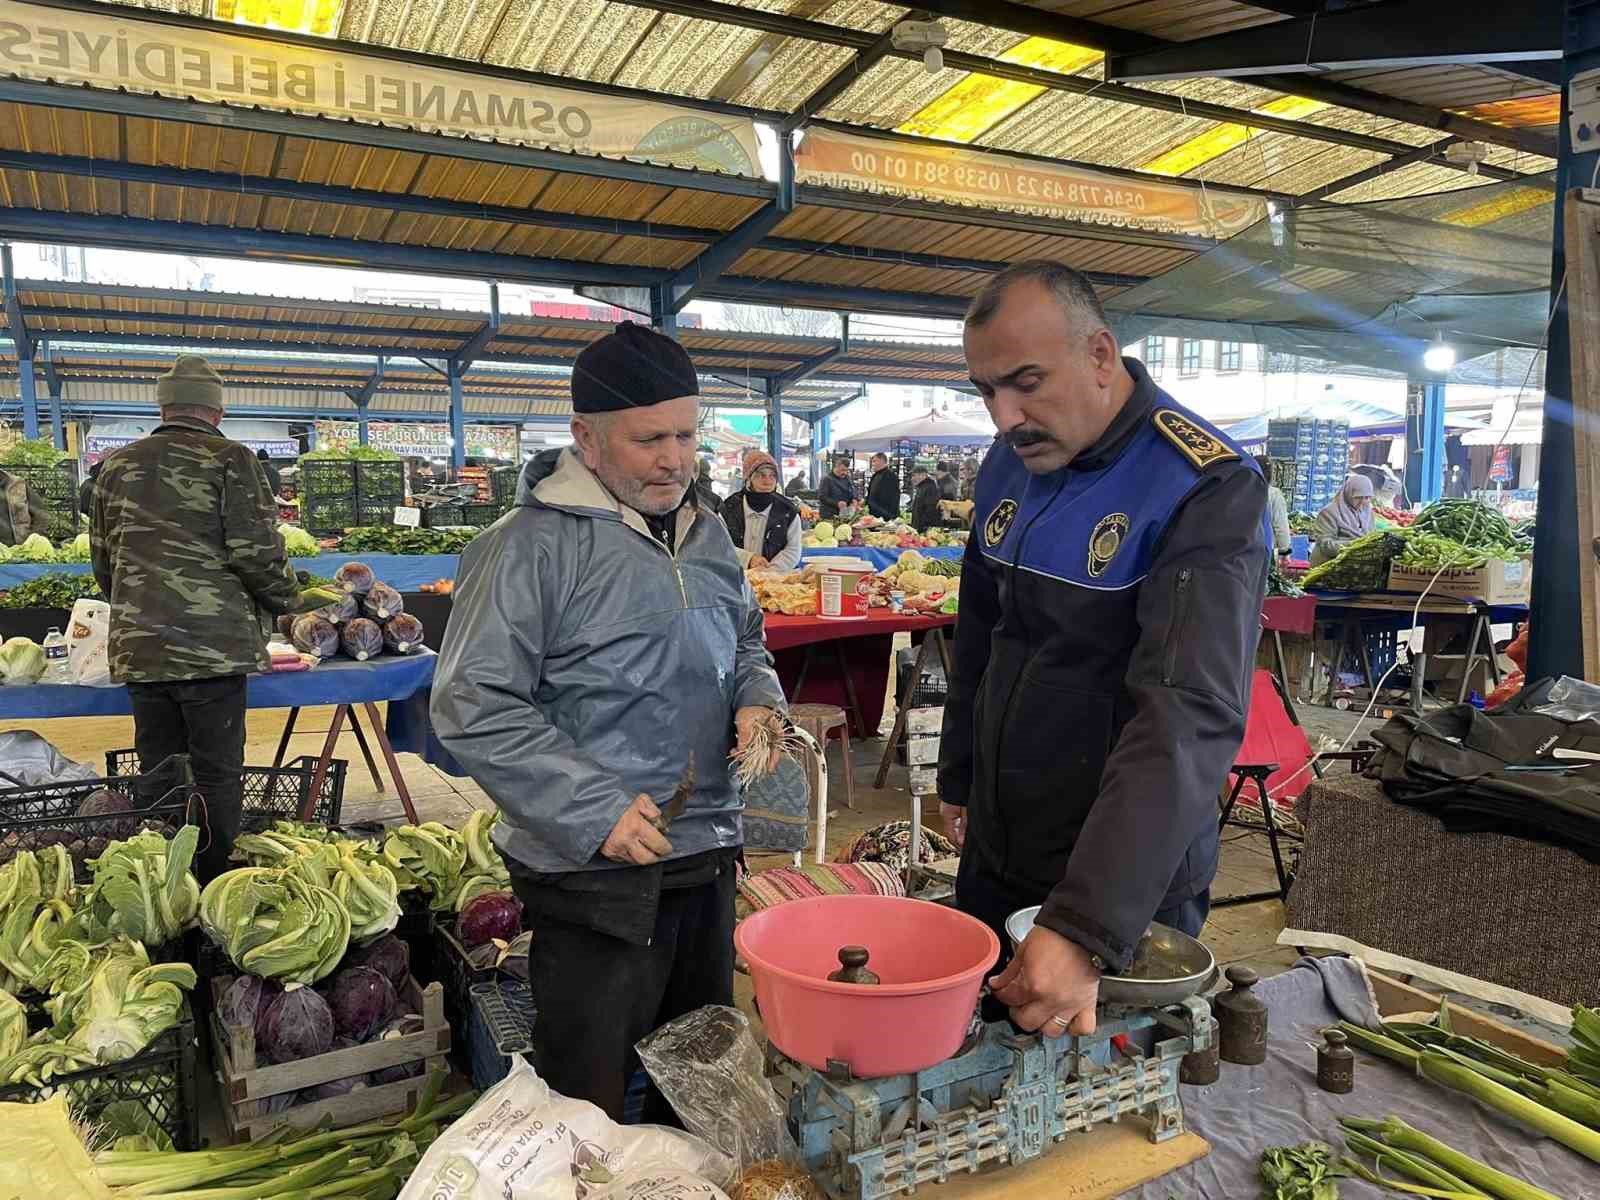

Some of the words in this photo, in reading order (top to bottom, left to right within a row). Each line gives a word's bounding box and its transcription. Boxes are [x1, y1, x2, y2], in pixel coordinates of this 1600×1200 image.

[1024, 1104, 1040, 1127] 10
[515, 1120, 544, 1147] ORTA
[497, 1149, 520, 1171] BOY
